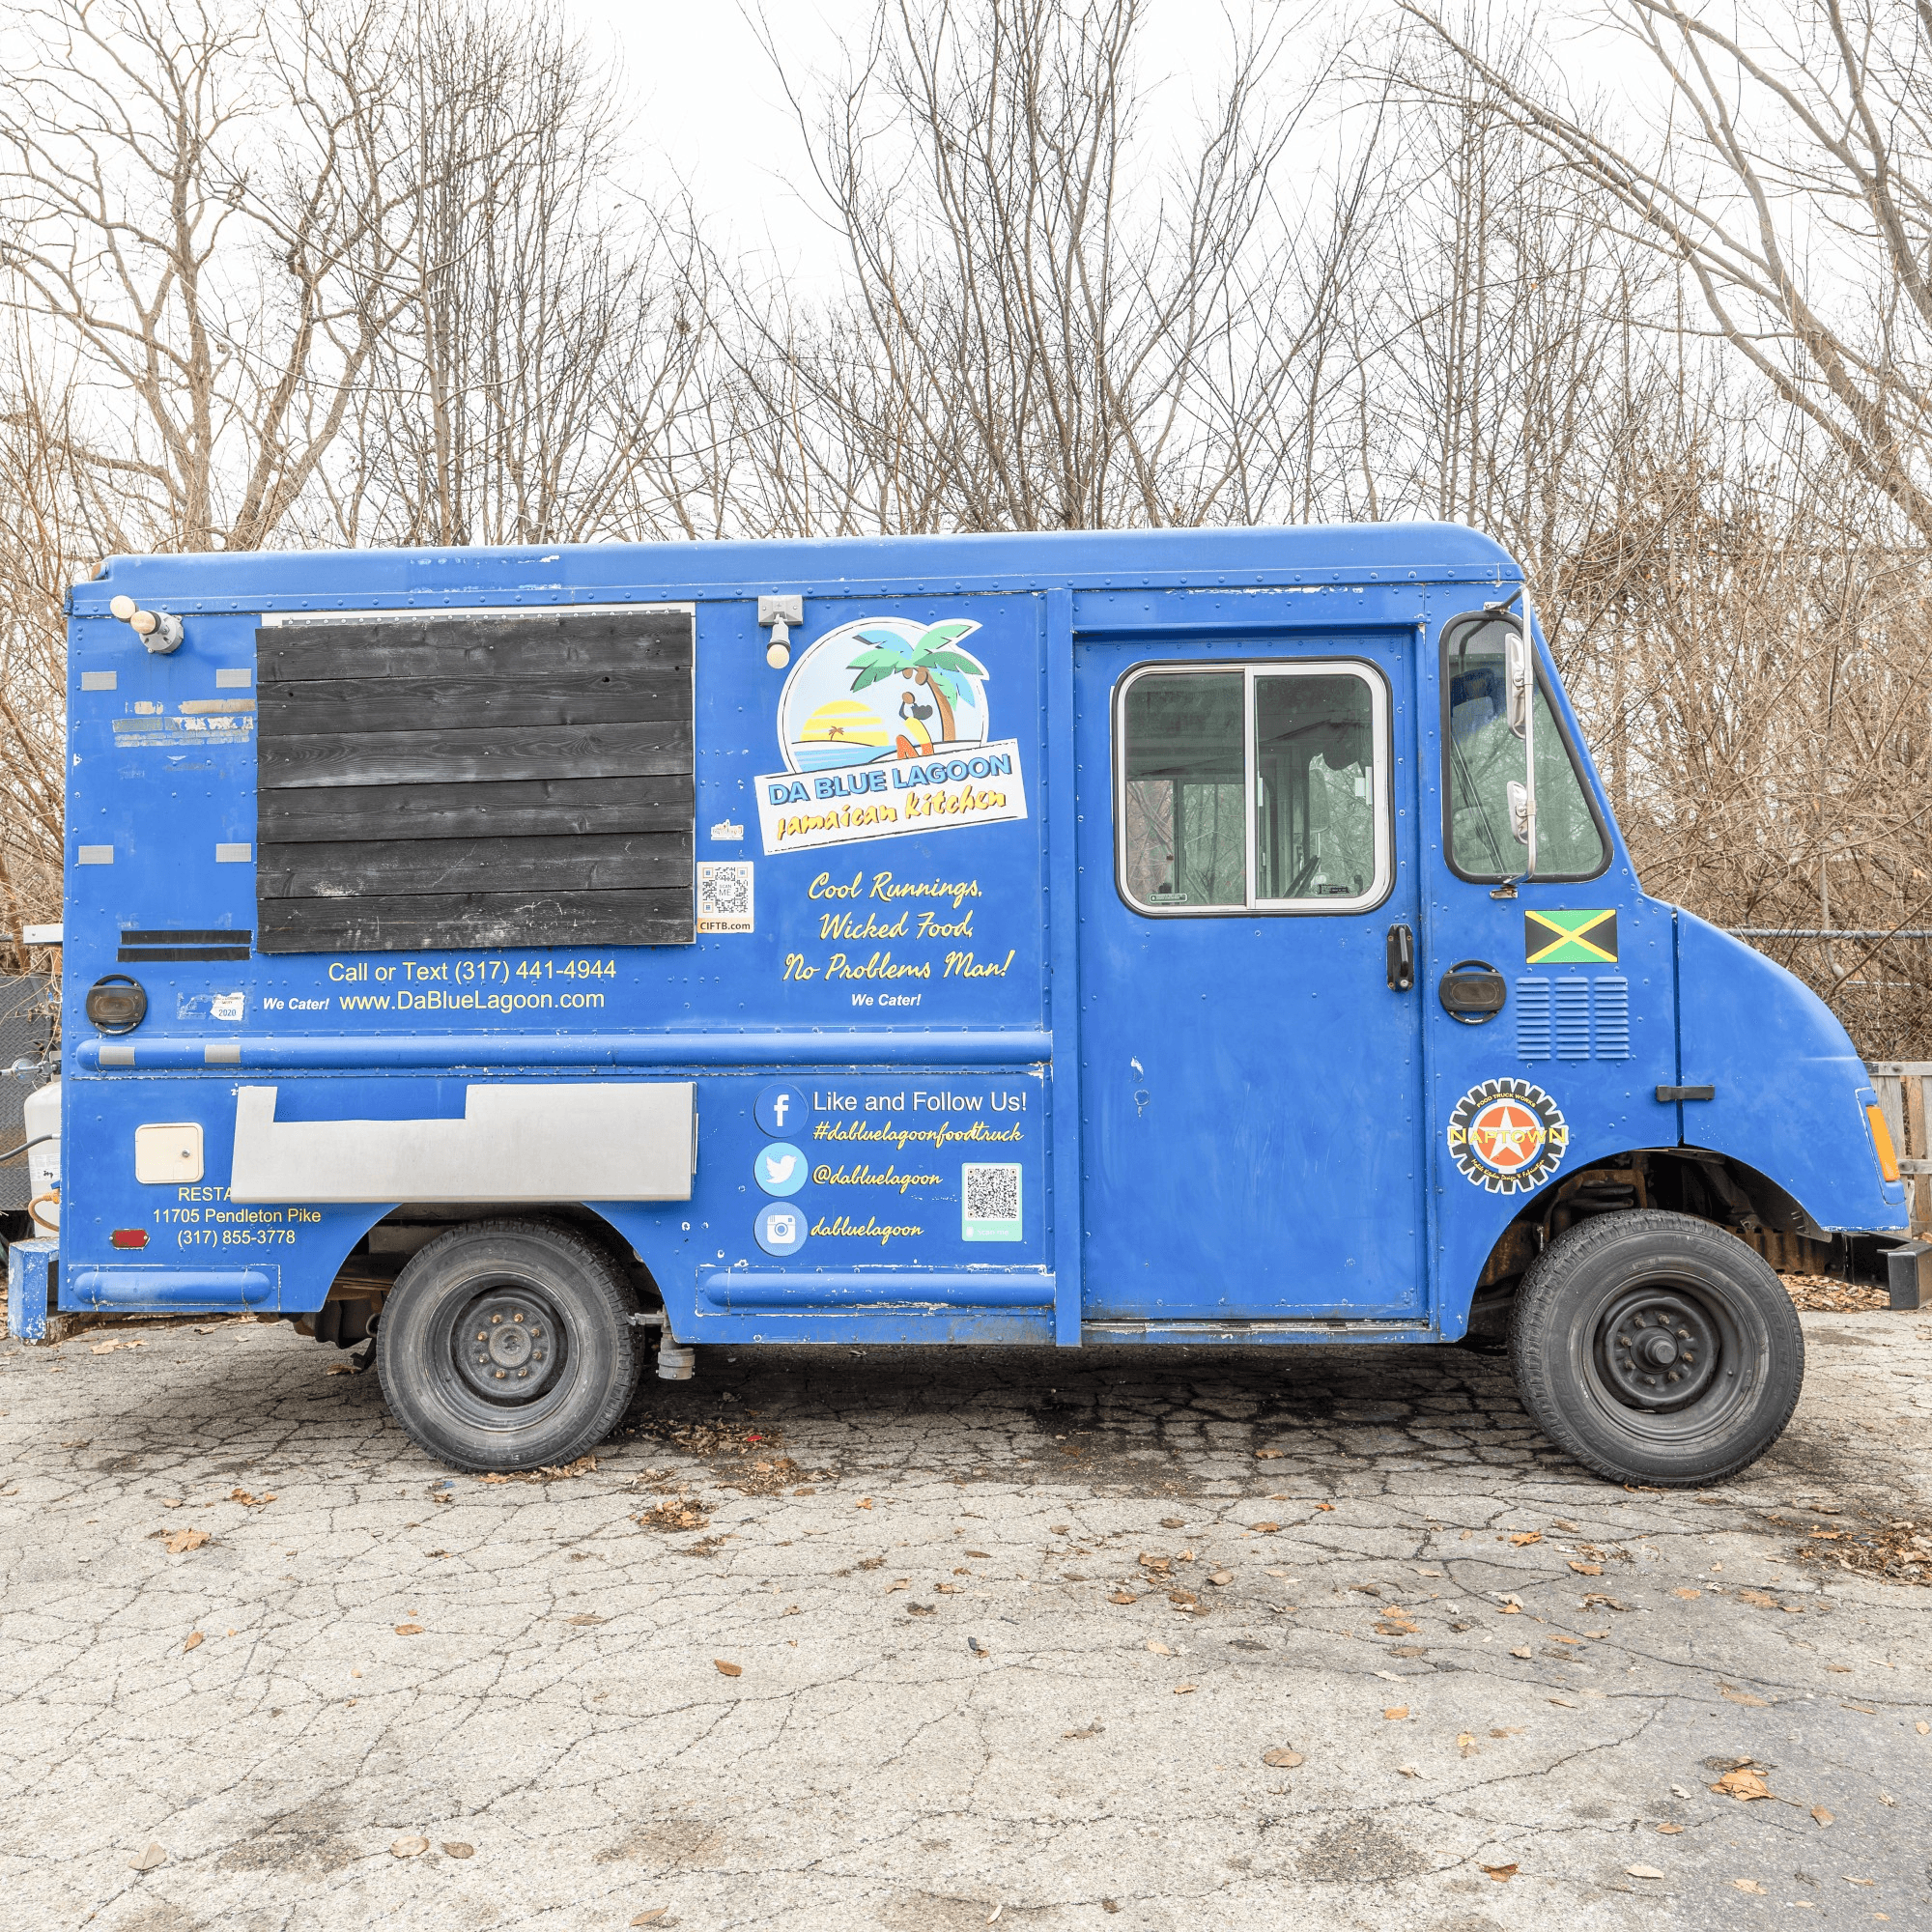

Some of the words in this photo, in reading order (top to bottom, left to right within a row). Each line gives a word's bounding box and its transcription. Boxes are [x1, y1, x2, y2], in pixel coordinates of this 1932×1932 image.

[769, 781, 810, 805] DA
[814, 771, 887, 799] BLUE
[892, 753, 1012, 789] LAGOON
[808, 871, 863, 899] Cool
[699, 922, 751, 930] CIFTB.com
[819, 911, 908, 940] Wicked
[328, 962, 368, 981] Call
[375, 966, 396, 980] or
[402, 961, 448, 980] Text
[455, 960, 509, 985] (317)
[516, 960, 616, 980] 441-4944
[782, 952, 820, 980] No
[824, 951, 931, 980] Problems
[943, 950, 1015, 979] Man!
[263, 998, 284, 1009] We
[288, 998, 330, 1010] Cater!
[339, 990, 605, 1014] www.DaBlueLagoon.com
[851, 994, 874, 1007] We
[878, 993, 922, 1007] Cater!
[218, 1009, 236, 1017] 2020
[812, 1092, 858, 1112] Like
[865, 1092, 905, 1112] and
[913, 1091, 983, 1112] Follow
[990, 1091, 1027, 1112] Us!
[1515, 1094, 1536, 1108] WORKS
[812, 1121, 1024, 1150] #dabluelagoonfoodtruck
[1450, 1127, 1567, 1144] NAPTOWN
[811, 1165, 943, 1194] @dabluelagoon
[153, 1208, 200, 1223] 11705
[205, 1208, 282, 1223] Pendleton
[288, 1208, 322, 1223] Pike
[177, 1230, 218, 1248] (317)
[222, 1230, 296, 1244] 855-3778
[810, 1216, 923, 1245] dabluelagoon
